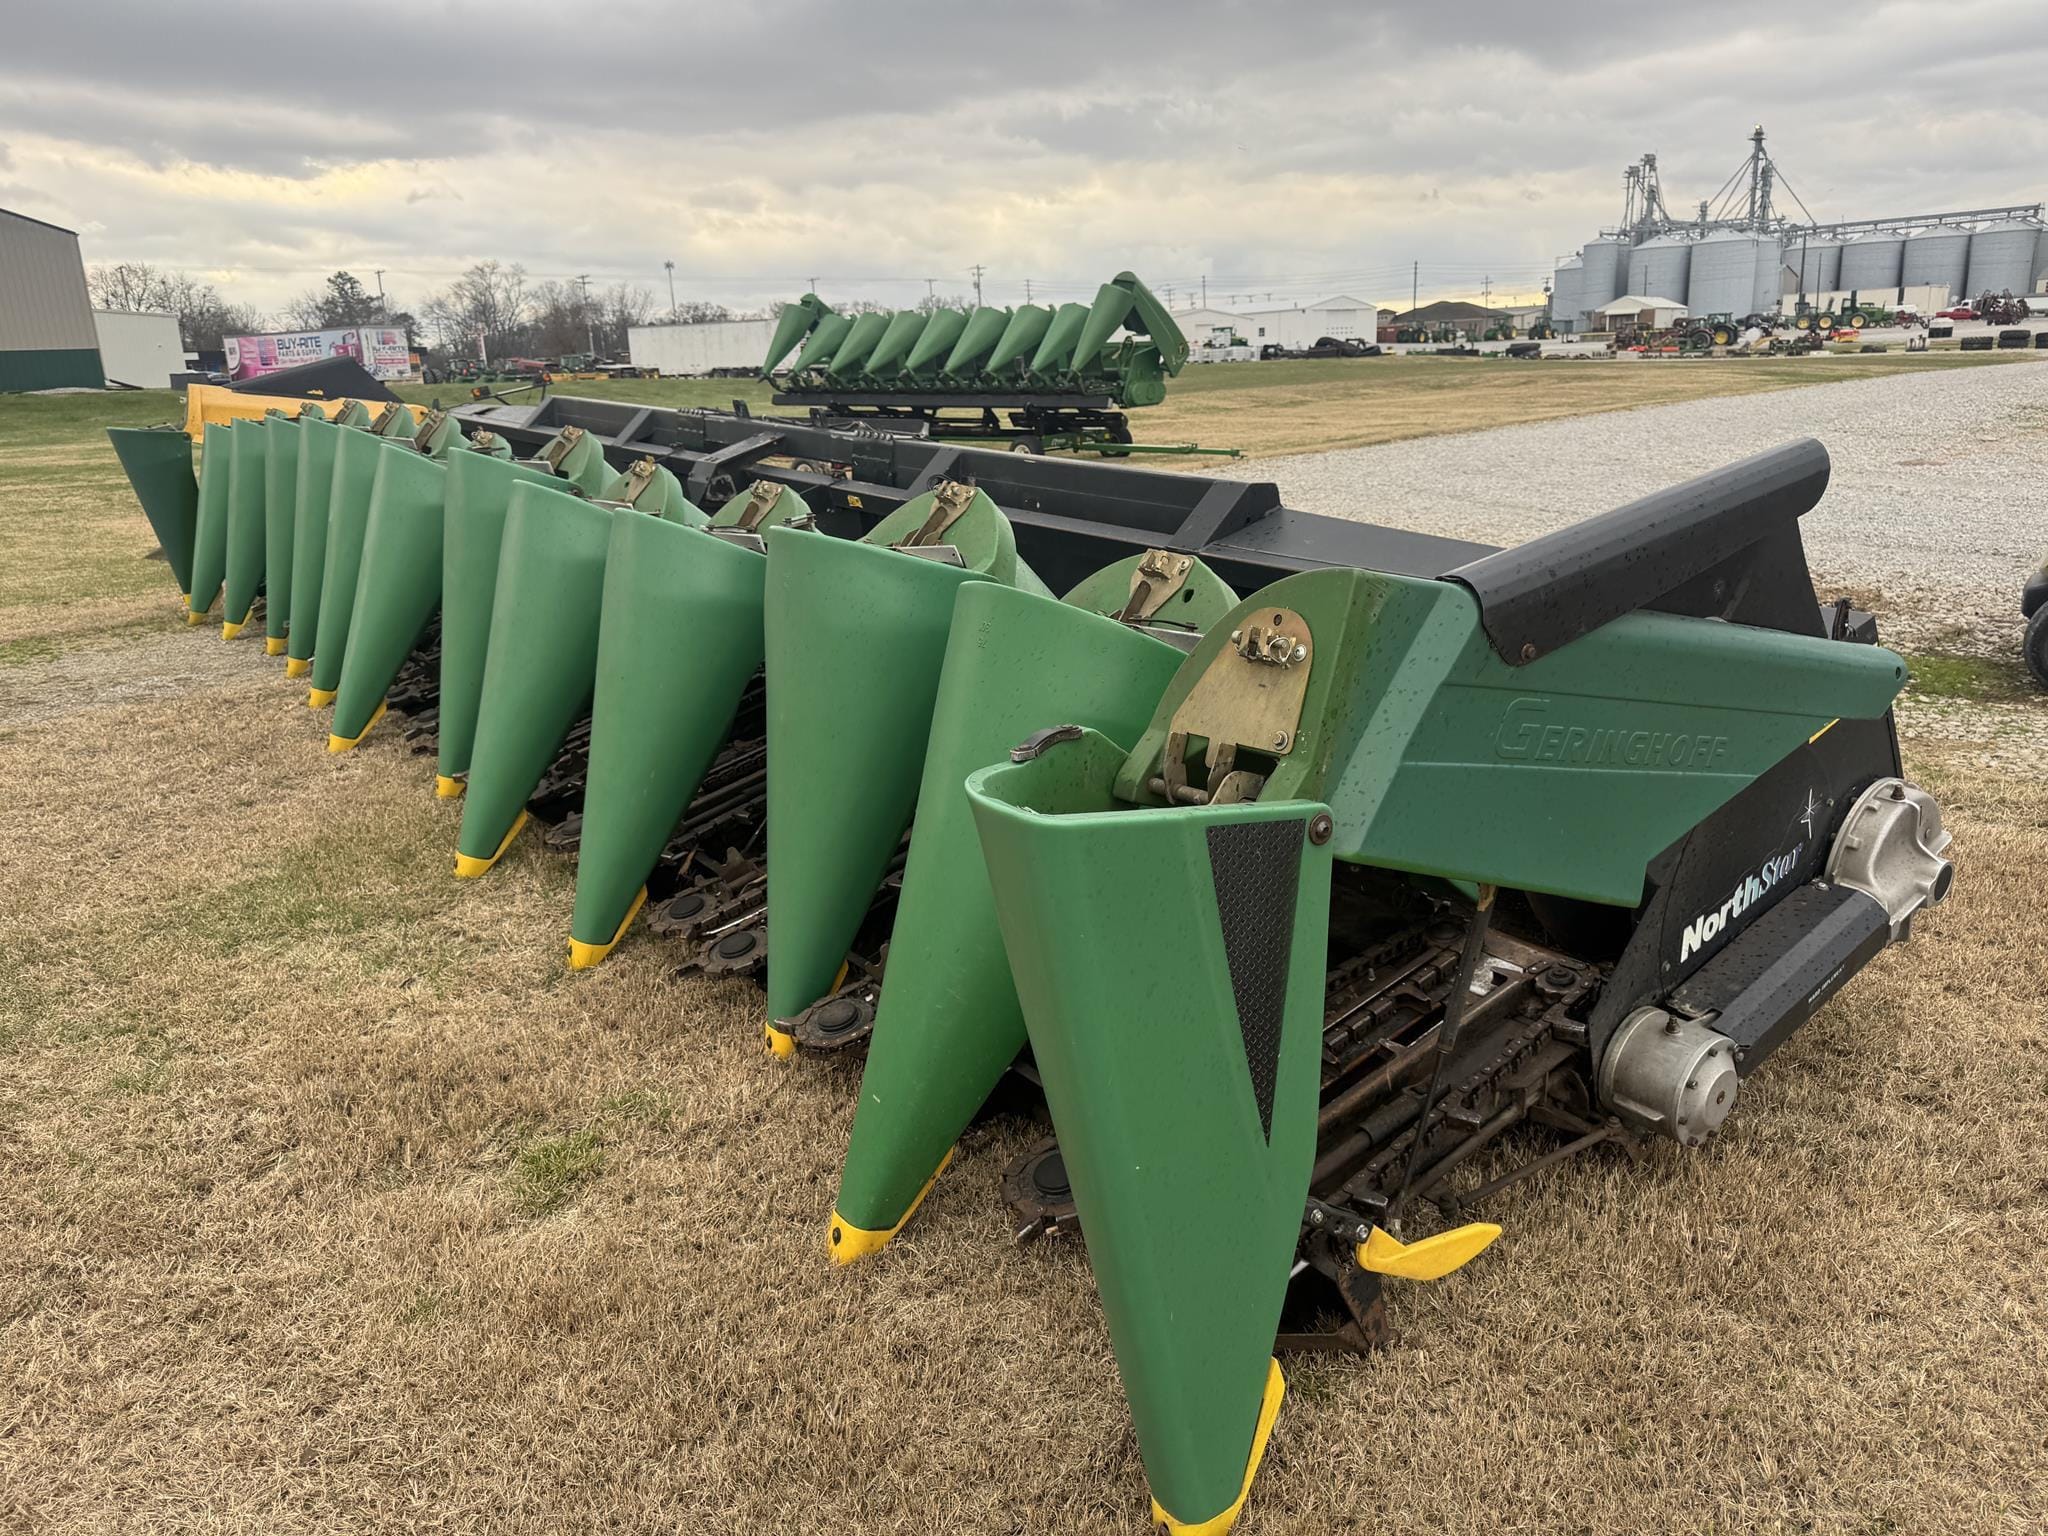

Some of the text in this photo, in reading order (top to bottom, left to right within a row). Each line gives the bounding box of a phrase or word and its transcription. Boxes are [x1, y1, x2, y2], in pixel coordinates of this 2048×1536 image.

[277, 336, 322, 350] BUY-RITE
[301, 348, 322, 356] SUPPLY
[1495, 697, 1728, 768] GERINGHOFF
[1680, 843, 1803, 963] NorthStar
